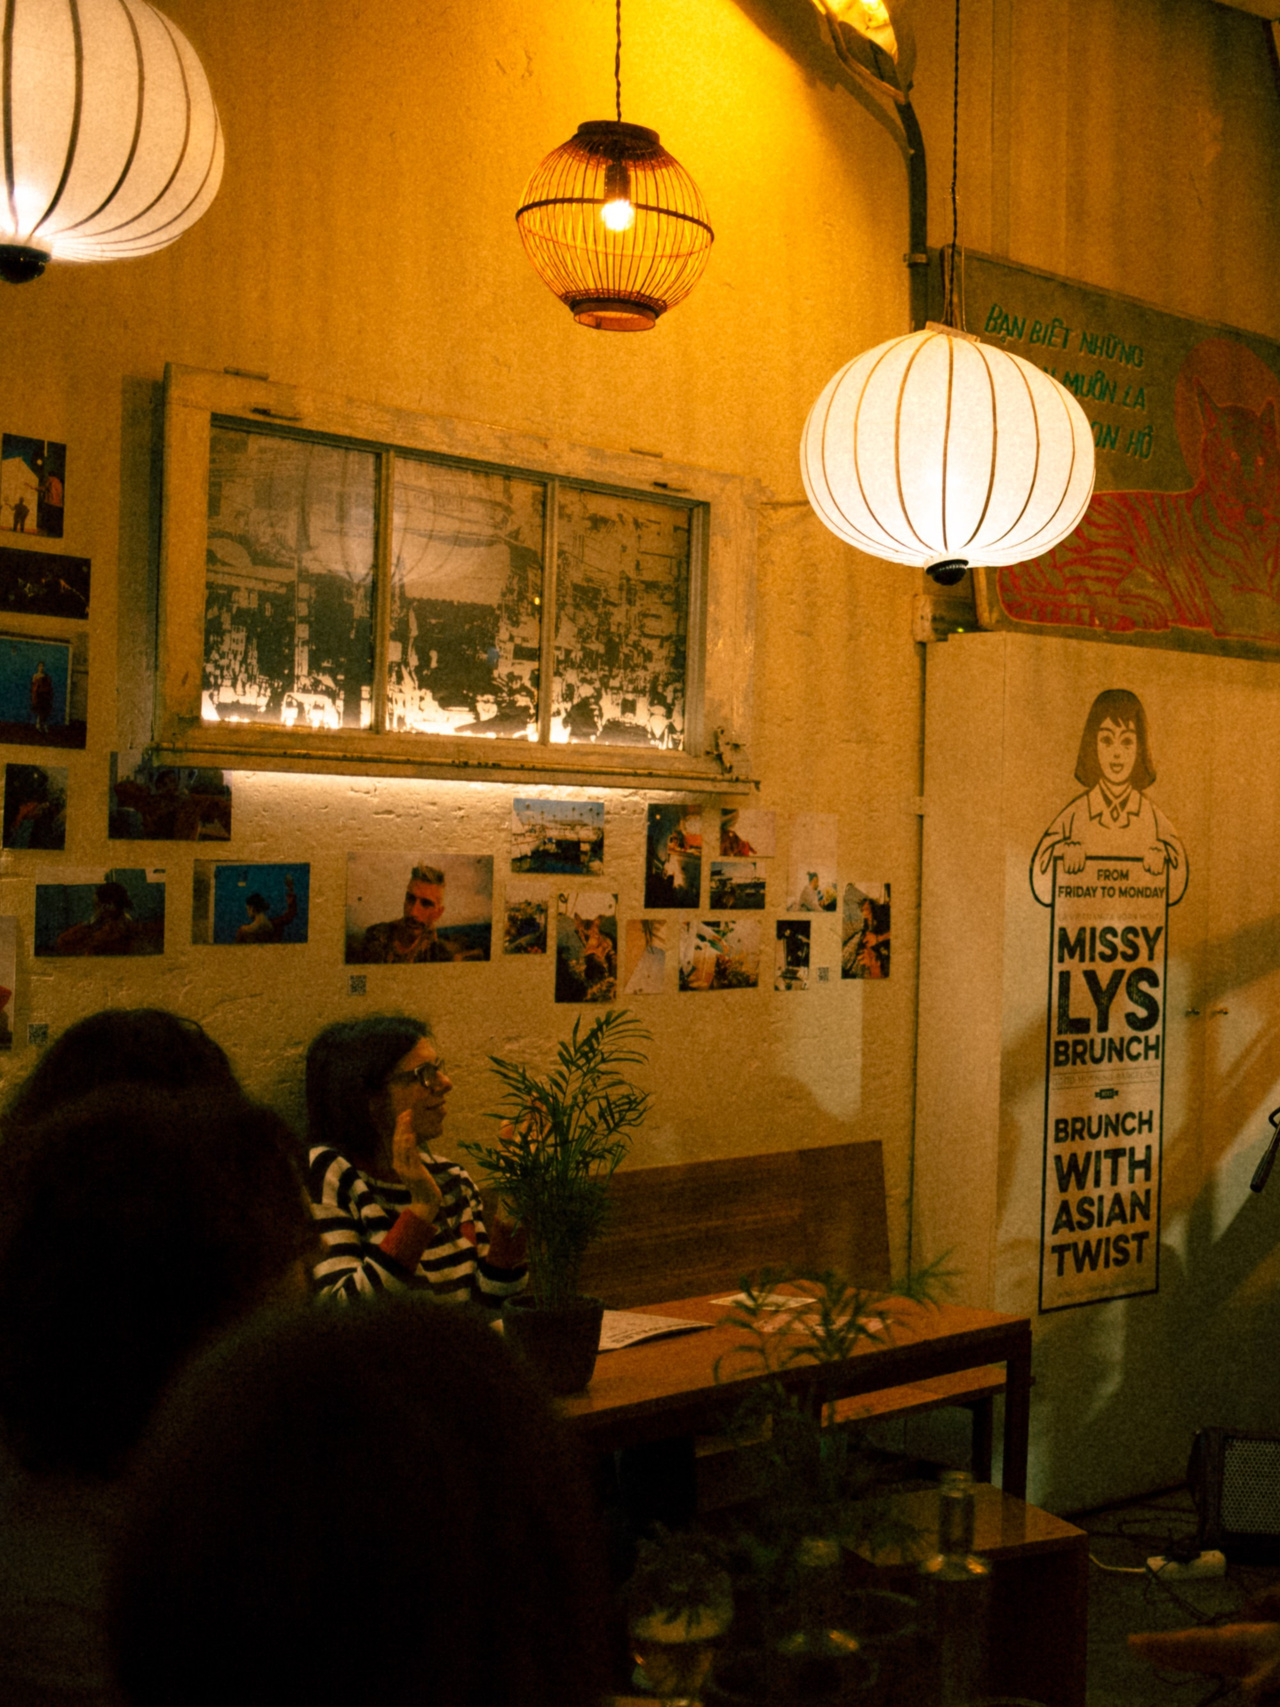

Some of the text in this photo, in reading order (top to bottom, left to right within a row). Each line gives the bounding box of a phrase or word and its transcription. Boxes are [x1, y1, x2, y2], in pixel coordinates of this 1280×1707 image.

[1058, 886, 1166, 899] FRIDAY TO MONDAY
[1097, 869, 1130, 881] FROM
[1057, 926, 1163, 963] MISSY
[1057, 967, 1160, 1035] LYS
[1053, 1035, 1160, 1067] BRUNCH
[1054, 1110, 1153, 1143] BRUNCH
[1054, 1145, 1151, 1193] WITH
[1052, 1189, 1151, 1235] ASIAN
[1051, 1231, 1149, 1277] TWIST
